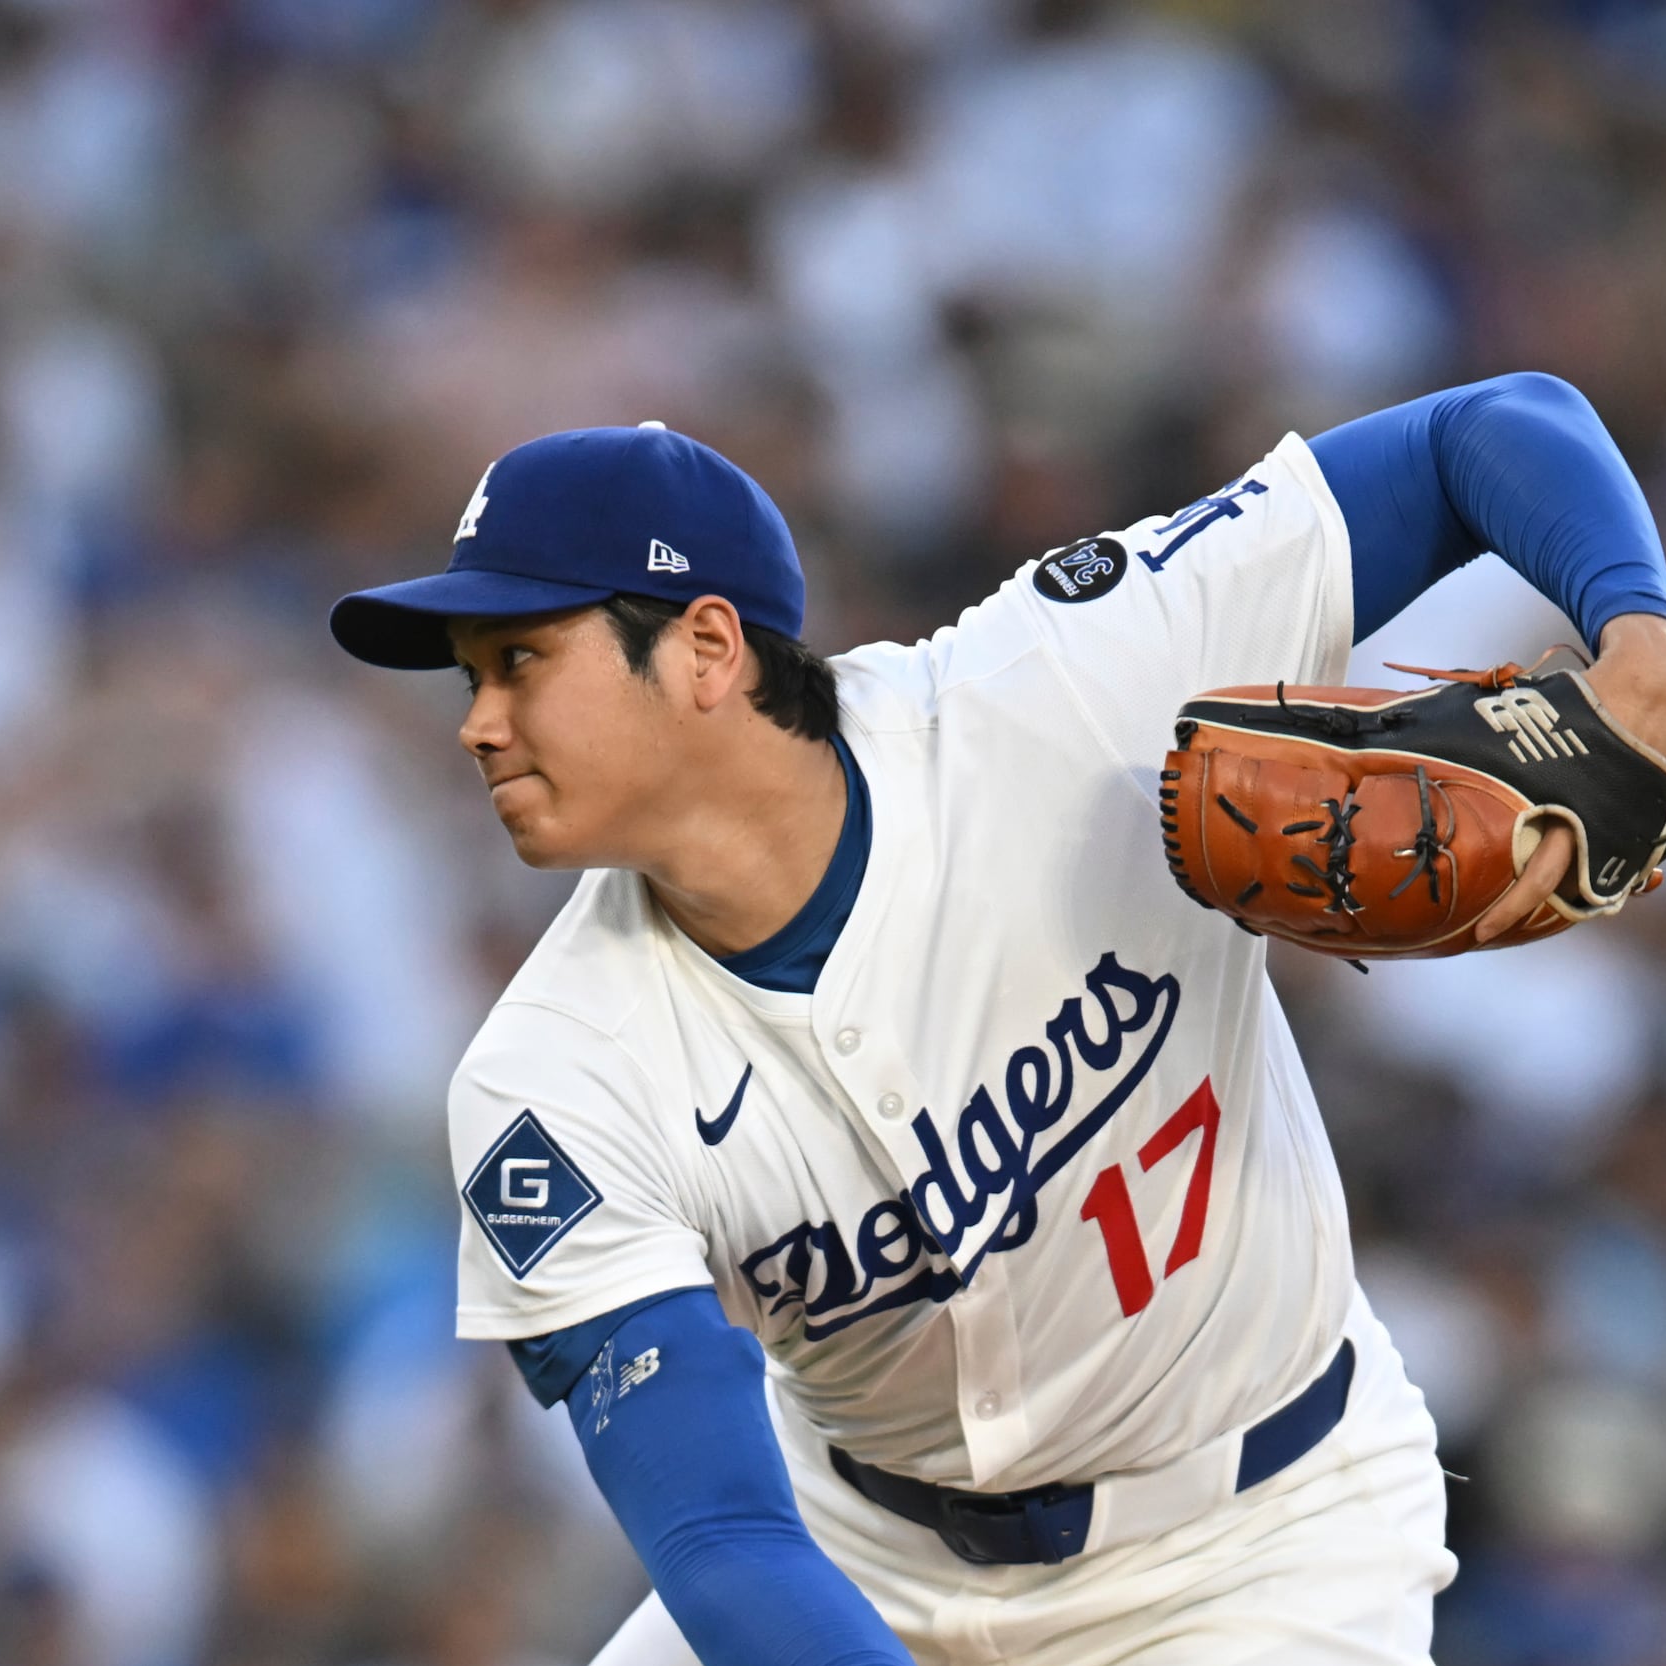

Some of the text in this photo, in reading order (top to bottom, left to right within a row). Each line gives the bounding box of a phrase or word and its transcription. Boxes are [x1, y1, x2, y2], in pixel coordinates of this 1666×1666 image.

[1060, 542, 1114, 585] 34
[738, 951, 1180, 1342] Dodgers
[500, 1158, 550, 1208] G
[1080, 1074, 1221, 1318] 17
[487, 1213, 561, 1226] GUGGENHEIM
